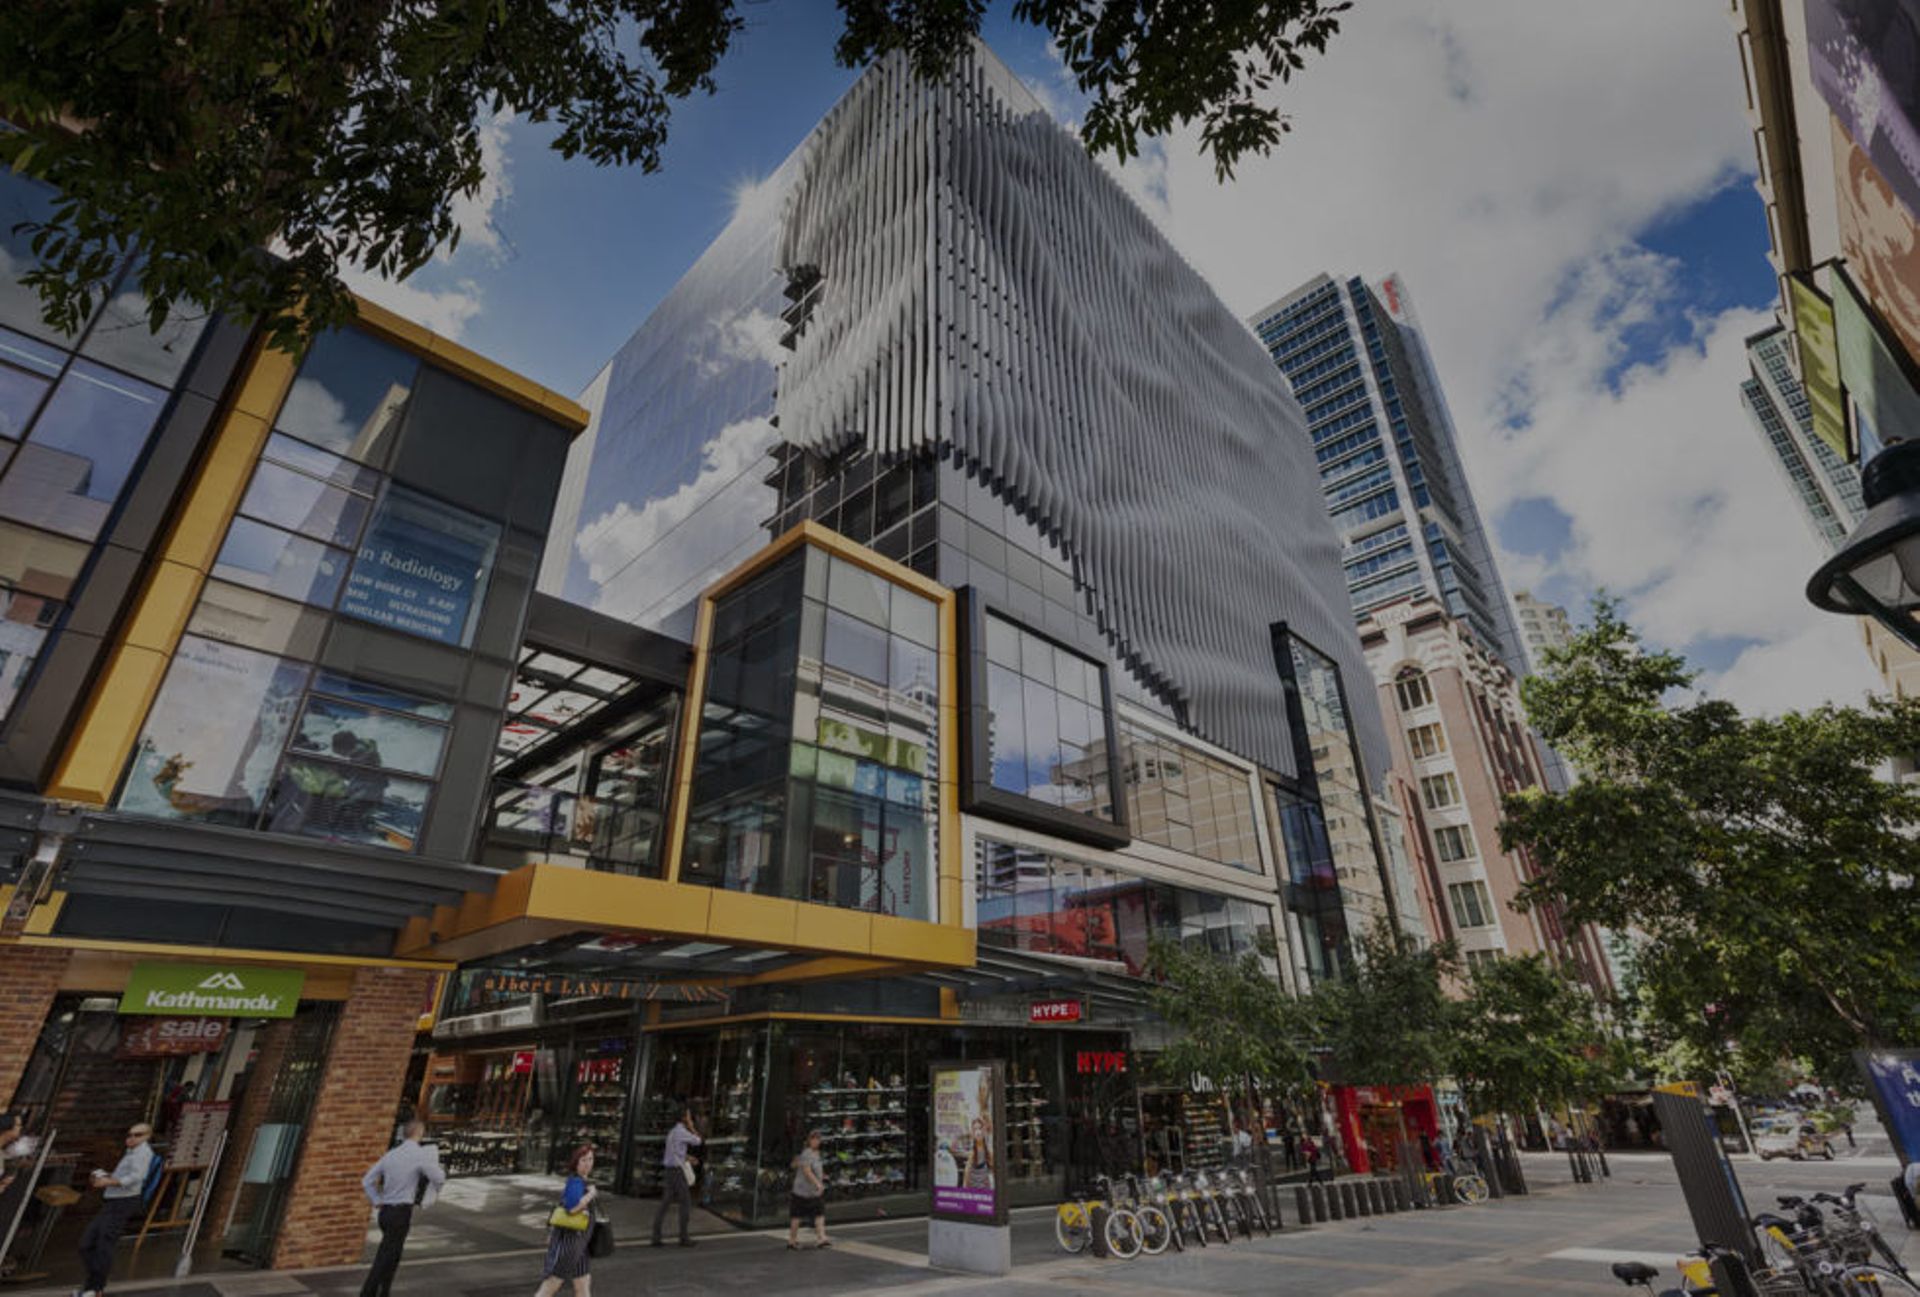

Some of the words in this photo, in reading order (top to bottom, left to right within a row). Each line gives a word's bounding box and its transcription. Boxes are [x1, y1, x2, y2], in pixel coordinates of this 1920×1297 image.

[381, 550, 463, 592] Radiology
[484, 975, 553, 993] albert
[145, 990, 278, 1011] Kathmandu
[1032, 1003, 1069, 1018] HYPE
[159, 1015, 223, 1038] sale
[1077, 1051, 1128, 1073] HYPE
